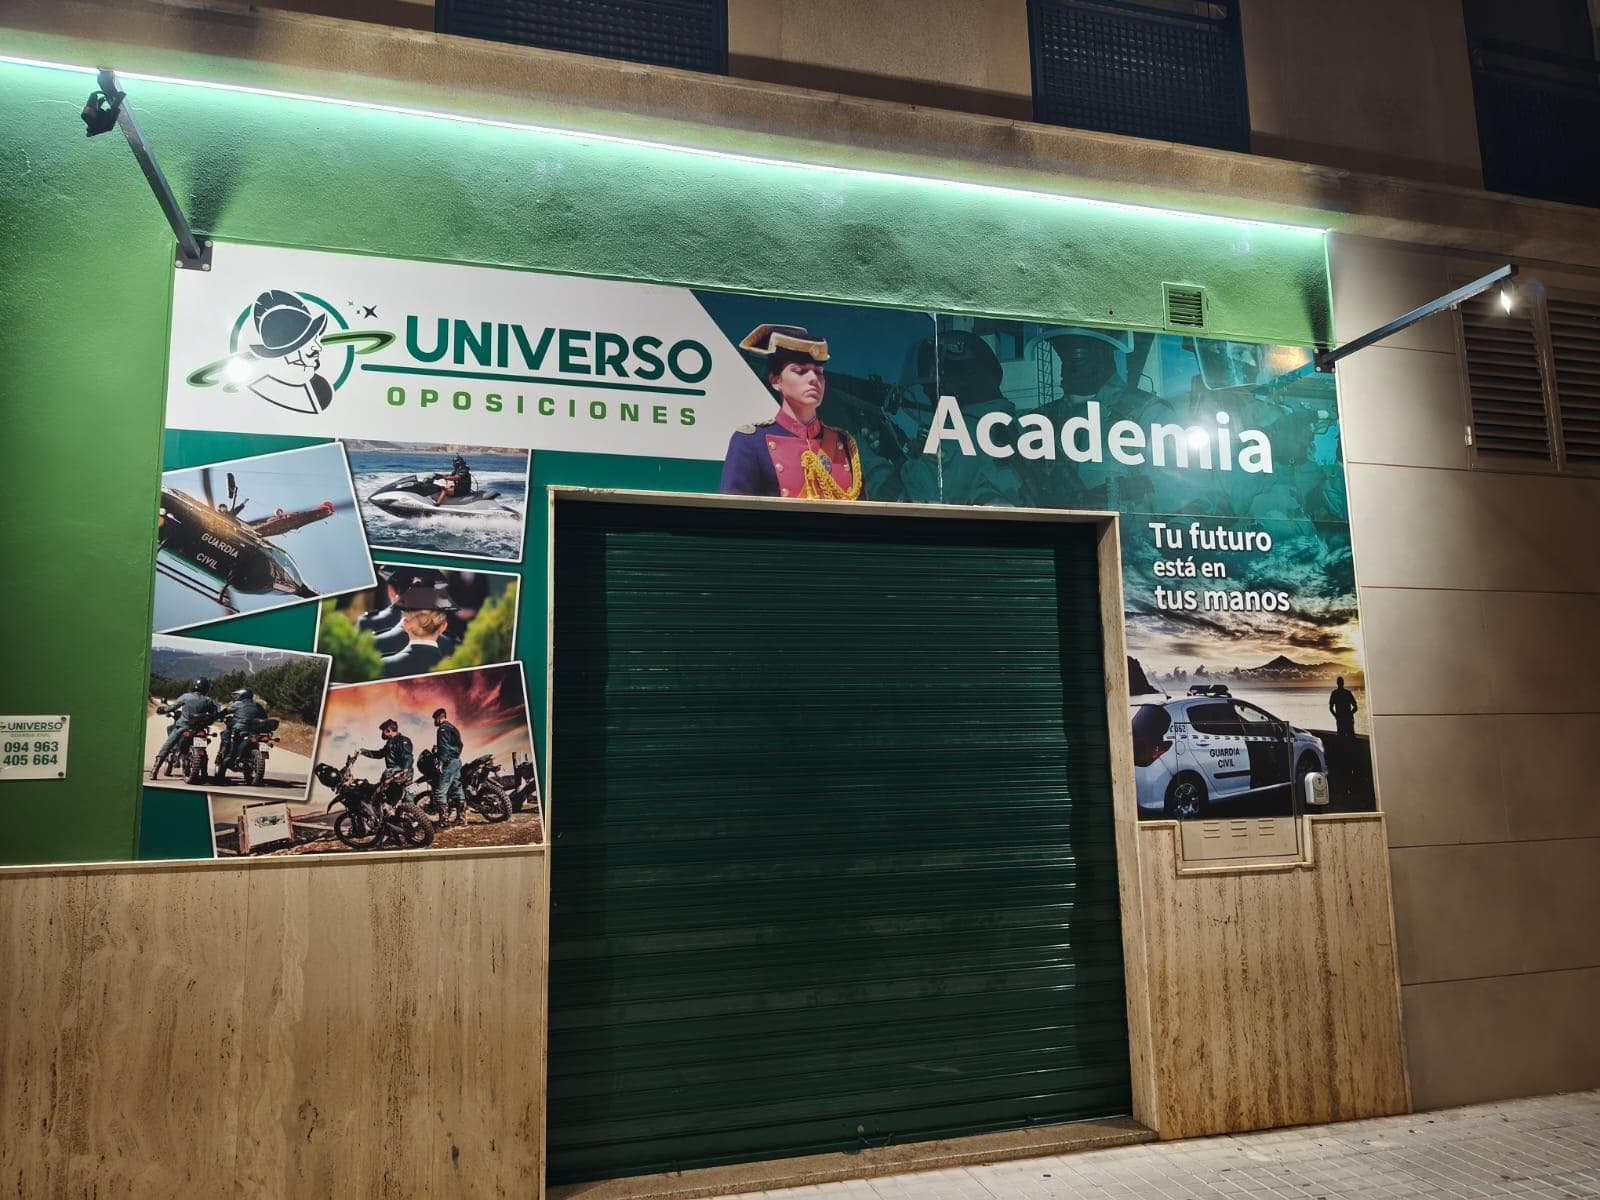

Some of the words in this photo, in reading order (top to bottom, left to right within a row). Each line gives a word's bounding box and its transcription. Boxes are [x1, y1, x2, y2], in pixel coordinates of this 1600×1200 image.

[406, 315, 713, 384] UNIVERSO
[387, 386, 697, 426] OPOSICIONES
[923, 395, 1274, 474] Academia
[201, 532, 240, 558] GUARDIA
[1148, 522, 1183, 549] Tu
[1189, 522, 1273, 552] futuro
[196, 552, 218, 570] CIVIL
[1153, 556, 1197, 578] está
[1201, 561, 1227, 578] en
[1154, 585, 1199, 611] tus
[1203, 589, 1291, 612] manos
[8, 722, 63, 730] UNIVERSO
[4, 741, 29, 753] 094
[34, 741, 59, 753] 963
[1209, 747, 1241, 758] GUARDIA
[3, 754, 29, 766] 405
[33, 754, 58, 766] 664
[1217, 759, 1235, 769] CIVIL
